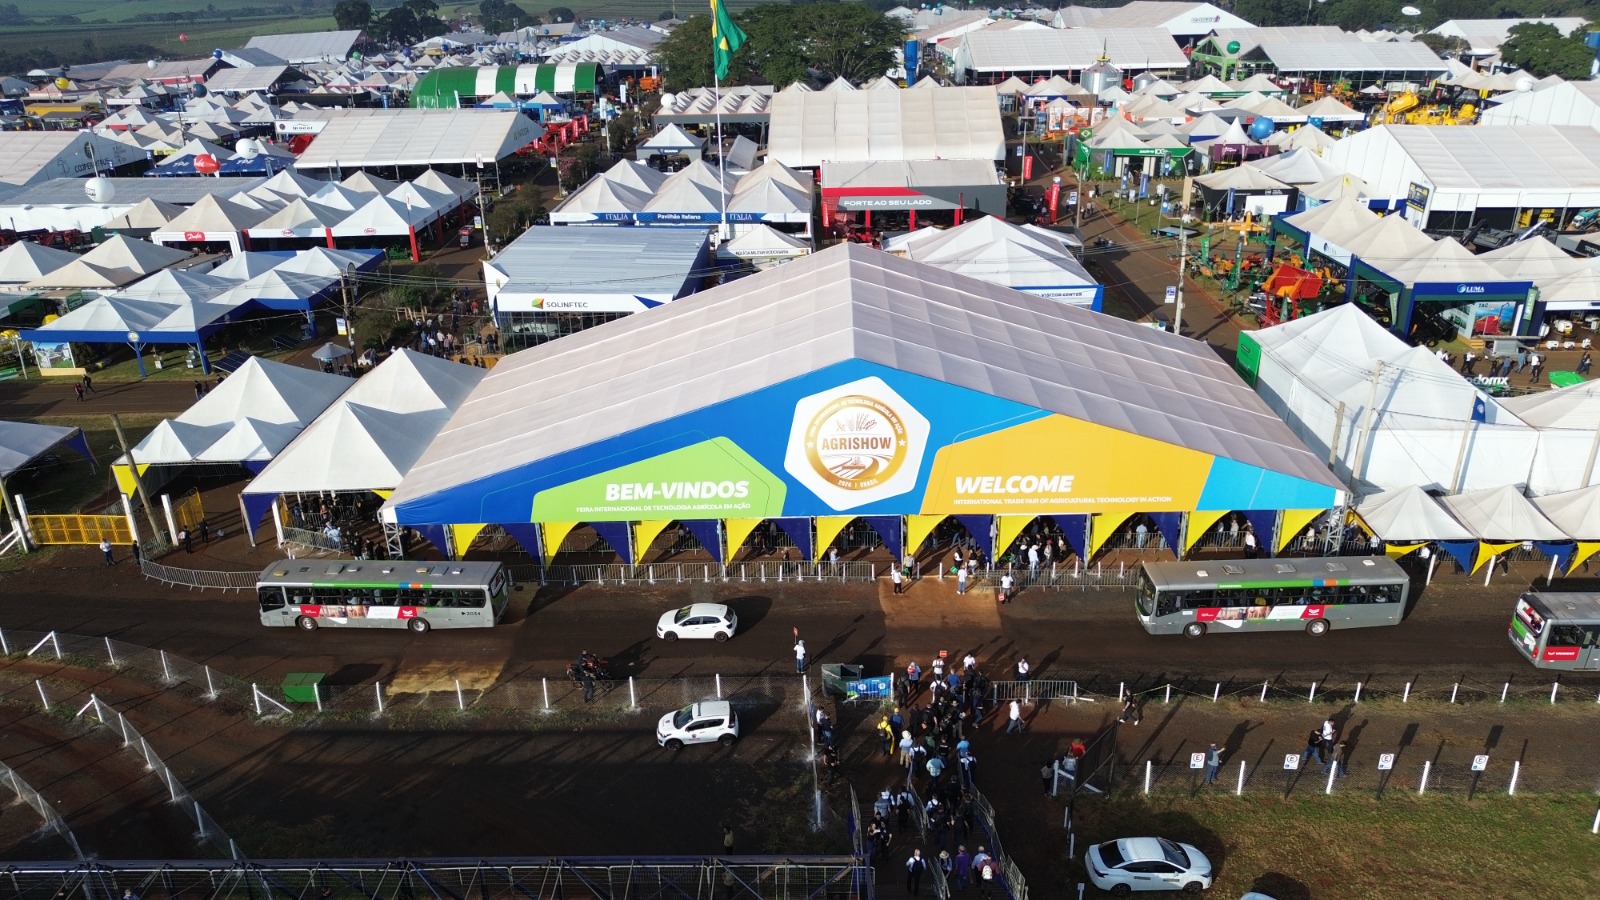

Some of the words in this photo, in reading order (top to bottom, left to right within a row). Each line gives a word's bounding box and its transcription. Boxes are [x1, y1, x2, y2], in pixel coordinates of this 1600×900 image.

[822, 437, 892, 450] AGRISHOW
[605, 481, 749, 501] BEM-VINDOS
[955, 475, 1074, 494] WELCOME
[733, 502, 751, 510] AÇÃO
